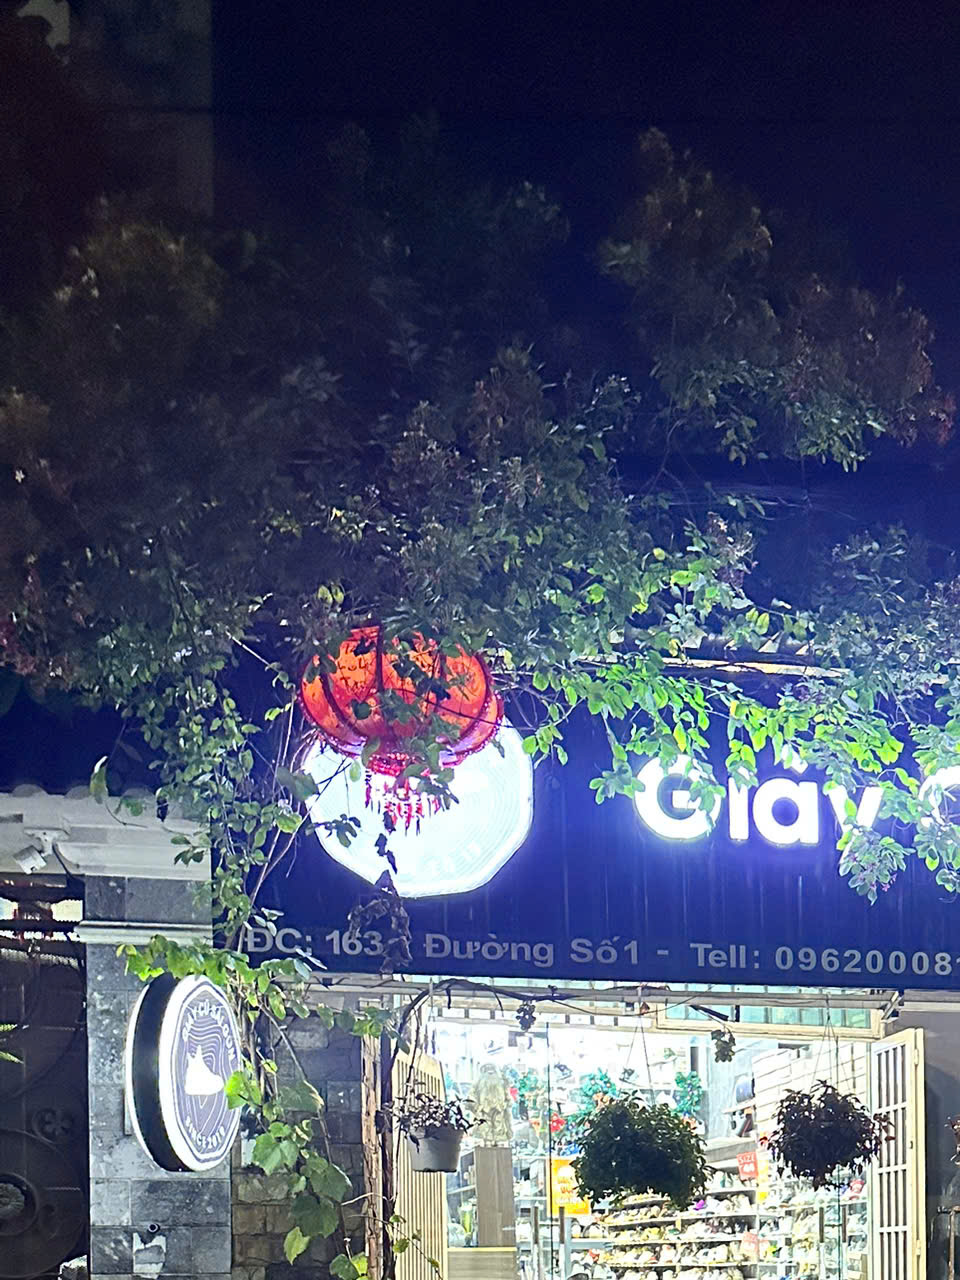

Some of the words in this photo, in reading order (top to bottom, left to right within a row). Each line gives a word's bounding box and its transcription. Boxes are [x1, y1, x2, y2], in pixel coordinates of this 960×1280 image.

[324, 929, 385, 956] 163
[423, 932, 555, 968] Đường
[689, 942, 760, 969] Tell:
